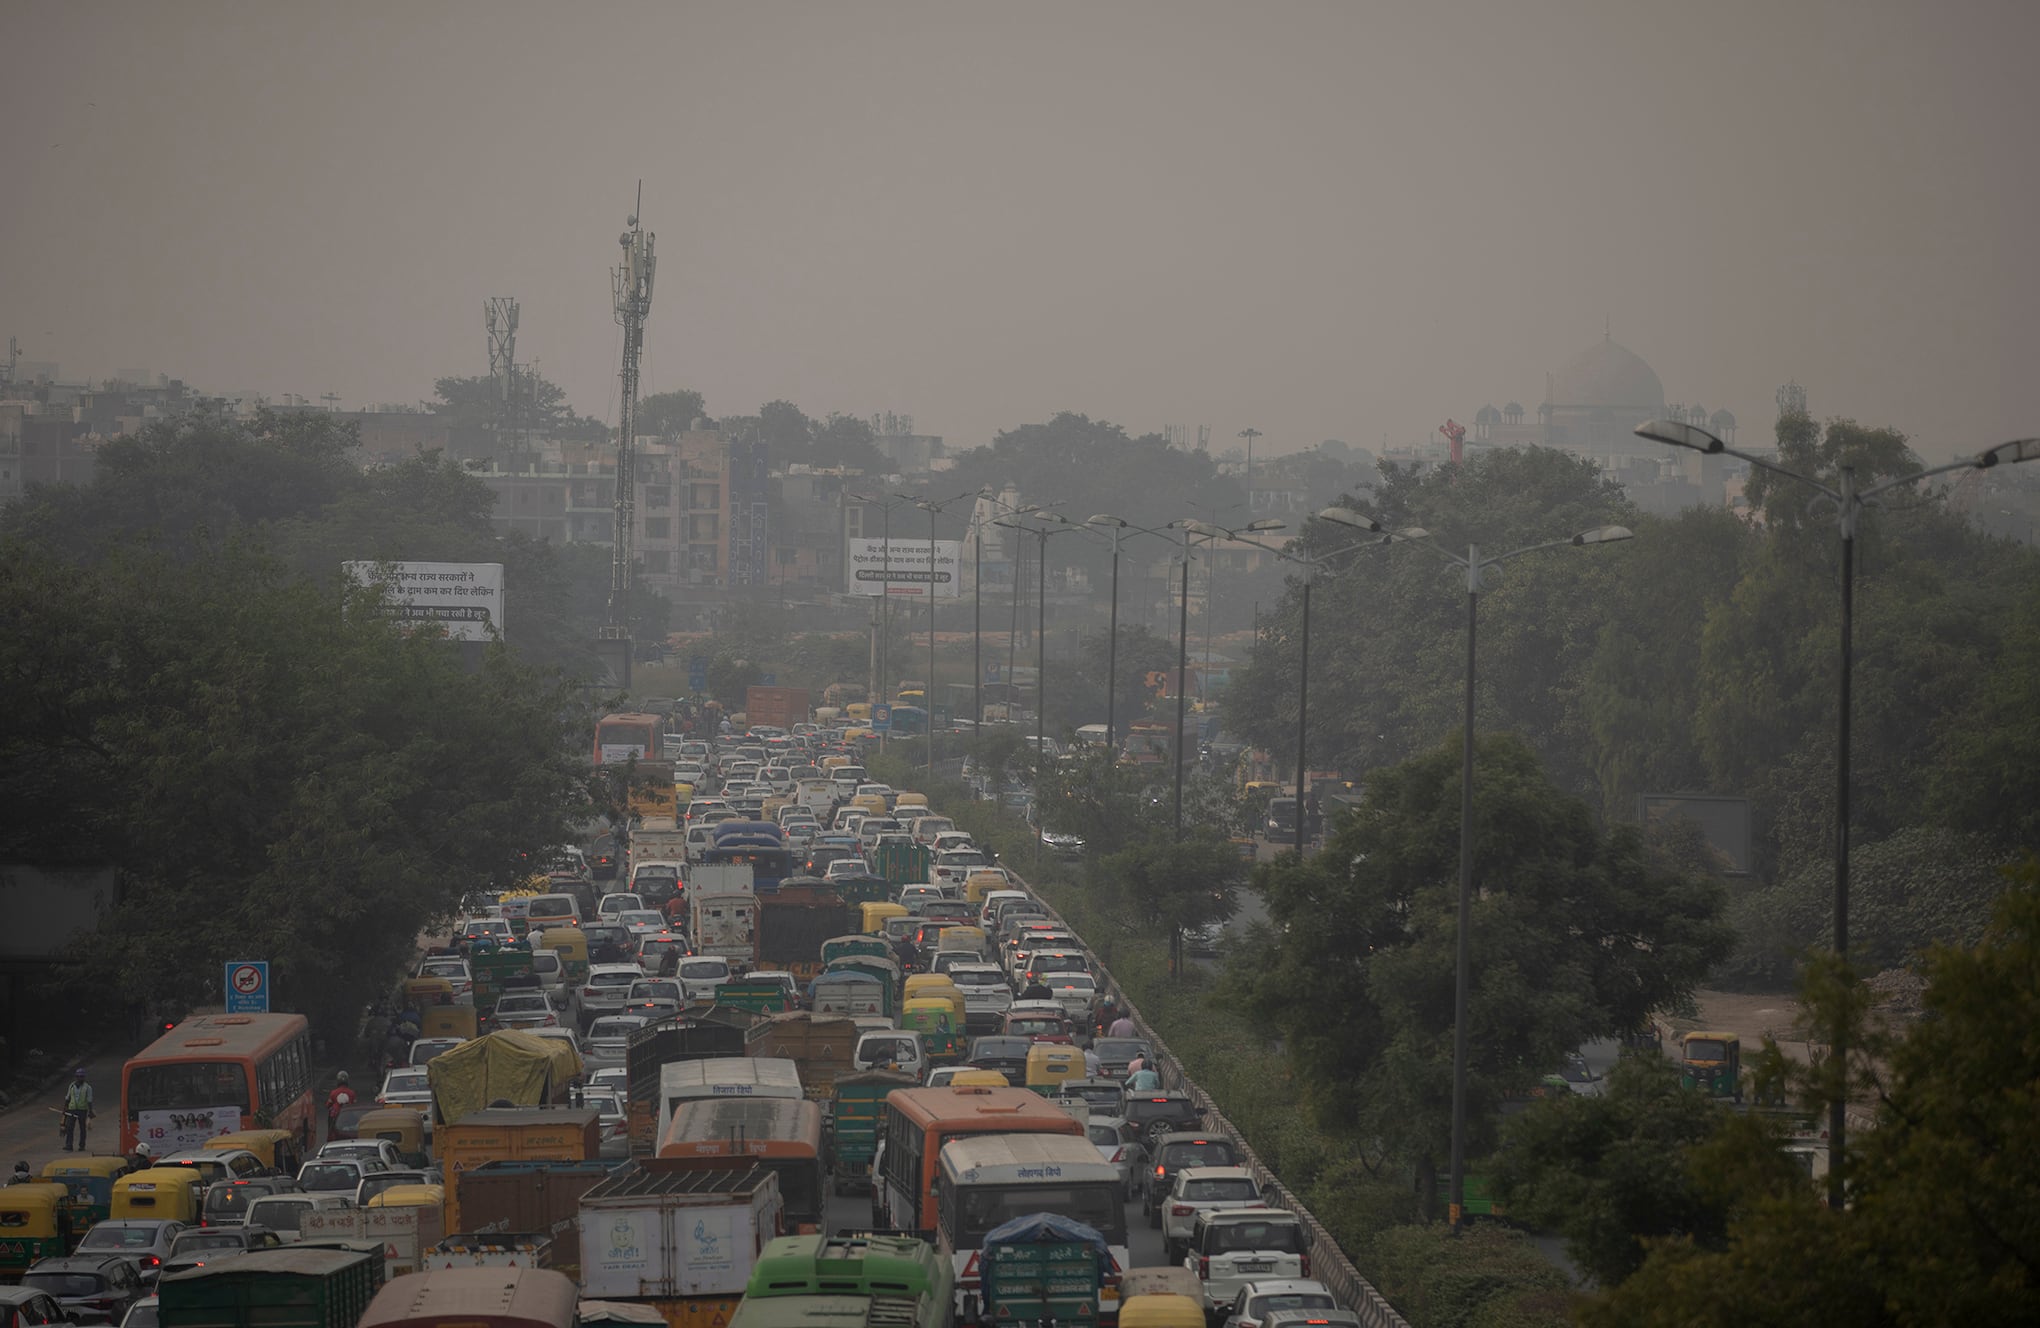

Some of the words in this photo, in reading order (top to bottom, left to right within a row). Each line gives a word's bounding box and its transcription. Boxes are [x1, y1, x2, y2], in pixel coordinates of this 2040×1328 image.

[419, 572, 436, 582] राज्य
[438, 571, 467, 582] सरकारों
[468, 572, 475, 582] ने
[408, 587, 422, 596] दाम
[424, 588, 438, 596] कम
[439, 588, 452, 596] कर
[454, 586, 469, 596] दिए
[470, 585, 494, 597] लेकिन
[412, 609, 424, 617] अब
[425, 608, 434, 617] भी
[713, 1085, 735, 1094] तिजारा
[737, 1085, 753, 1094] डिपो
[1045, 1166, 1061, 1177] डिपो
